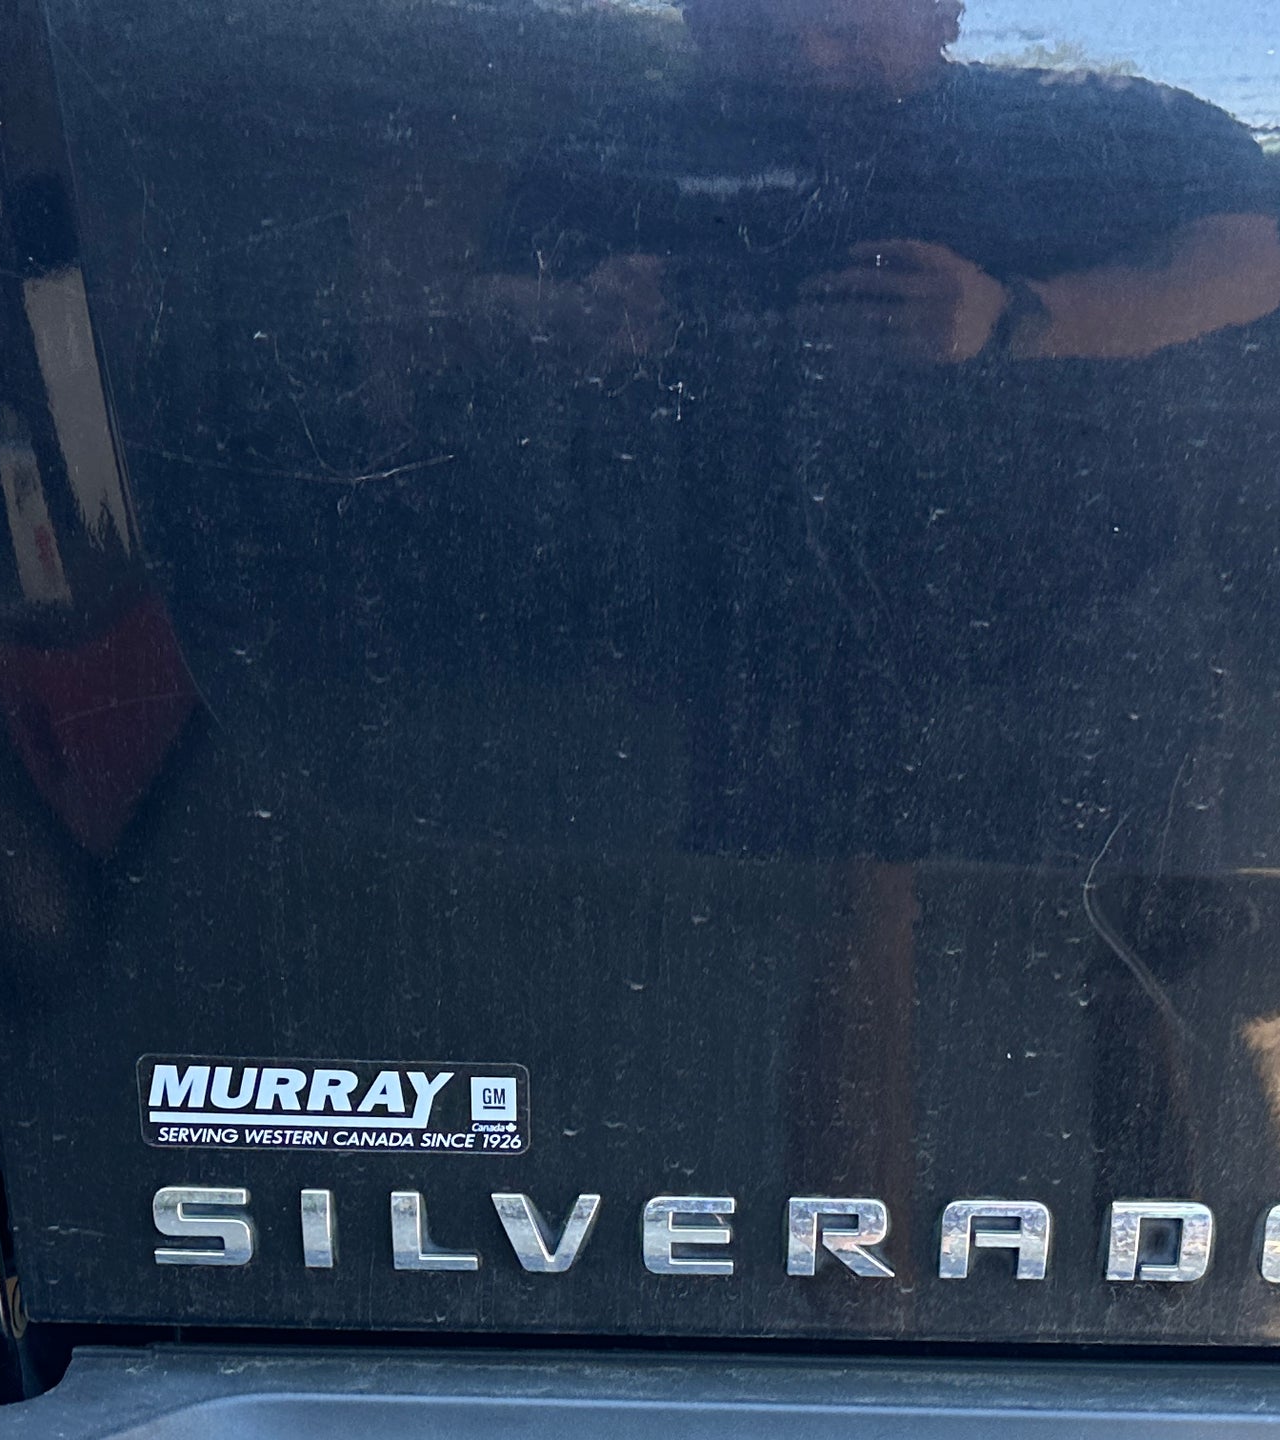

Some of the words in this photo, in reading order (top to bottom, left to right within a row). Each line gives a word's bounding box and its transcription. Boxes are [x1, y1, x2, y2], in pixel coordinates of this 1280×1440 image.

[148, 1063, 455, 1129] MURRAY
[481, 1087, 507, 1105] GM
[157, 1126, 239, 1144] SERVING
[244, 1128, 329, 1146] WESTERN
[332, 1131, 415, 1148] CANADA
[420, 1132, 476, 1149] SINCE
[482, 1133, 522, 1150] 1926
[471, 1122, 506, 1134] Canada
